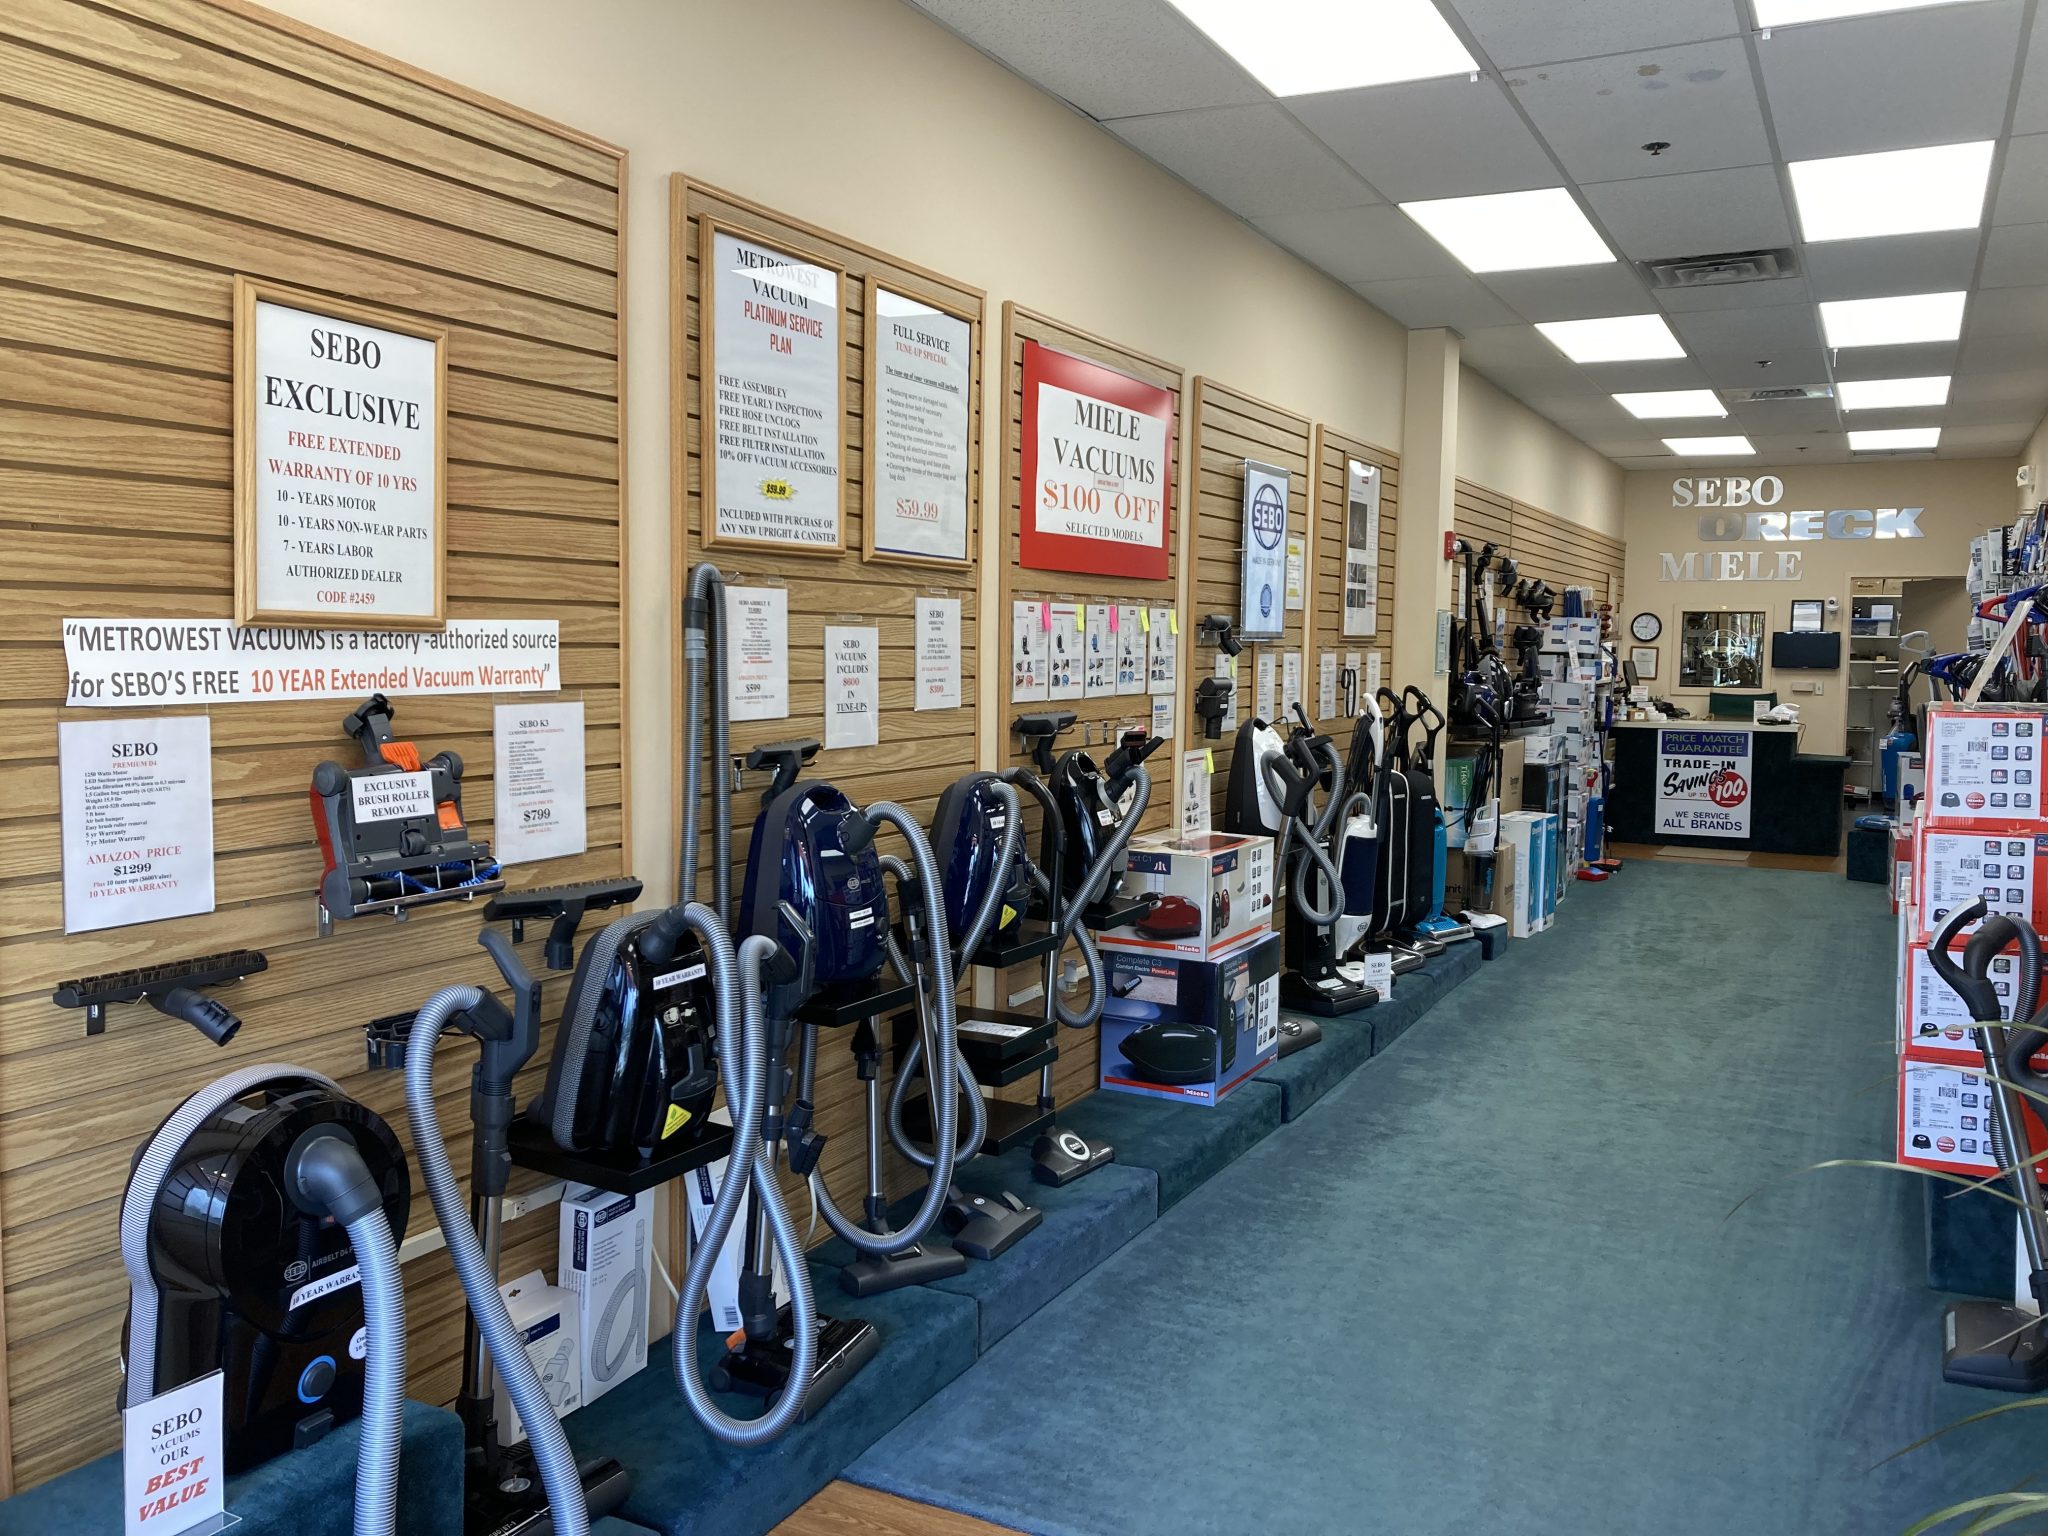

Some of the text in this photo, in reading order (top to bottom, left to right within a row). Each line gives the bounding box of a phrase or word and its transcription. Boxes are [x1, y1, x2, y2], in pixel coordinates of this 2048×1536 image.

[736, 247, 819, 289] METROWEST
[752, 279, 808, 309] VACUUM
[744, 300, 822, 338] PLATINUM SERVICE
[770, 334, 792, 355] PLAN
[893, 324, 950, 352] FULL SERVICE
[310, 329, 380, 369] SEBO
[923, 351, 947, 366] SPECIAL
[719, 375, 787, 398] FREE ASSEMBLEY
[265, 376, 419, 430] EXCLUSIVE
[719, 390, 822, 419] FREE YEARLY INSPECTIONS
[719, 405, 800, 429] FREE HOSE UNCLOGS
[1075, 399, 1140, 441] MIELE
[719, 419, 818, 445] FREE BELT INSTALLATION
[288, 431, 401, 461] FREE EXTENDED
[719, 434, 825, 461] FREE FILTER INSTALLATION
[719, 449, 837, 476] 10% OFF VACUUM ACCESSORIES
[1053, 437, 1155, 485] VACUUMS
[269, 459, 417, 492] WARRANTY OF 10 YRS
[277, 490, 376, 511] 10 YEARS MOTOR
[1043, 479, 1160, 524] $100 OFF
[1672, 475, 1784, 507] SEBO
[720, 508, 834, 529] INCLUDED WITH PURCHASE OF
[896, 497, 938, 519] $59.99
[1254, 503, 1282, 530] SEBO
[278, 515, 428, 539] 10 YEARS NON-WEAR PARTS
[720, 523, 836, 543] ANY NEW UPRIGHT & CANISTER
[1065, 522, 1143, 542] SELECTED MODELS
[1697, 507, 1925, 542] ORECK
[283, 540, 373, 558] 7 YEARS LABOR
[286, 565, 402, 583] AUTHORIZED DEALER
[1658, 551, 1803, 582] MIELE
[317, 590, 375, 605] CODE #2459
[228, 628, 325, 651] VACUUMS
[331, 631, 346, 649] is
[349, 634, 358, 649] a
[363, 631, 419, 652] factory
[512, 634, 557, 649] source
[843, 640, 860, 649] SEBO
[835, 652, 867, 661] VACUUMS
[837, 665, 868, 674] INCLUDES
[71, 673, 105, 699] for
[193, 670, 239, 693] FREE
[251, 670, 273, 692] 10
[279, 670, 324, 692] YEAR
[331, 667, 407, 690] Extended
[413, 667, 474, 689] Vacuum
[746, 684, 761, 693] $599
[843, 677, 860, 687] $600
[848, 690, 855, 699] IN
[837, 703, 868, 712] TUNE-UPS
[519, 720, 538, 728] SEBO
[1666, 733, 1744, 744] PRICE MATCH
[1667, 744, 1743, 754] GUARANTEE
[112, 742, 158, 758] SEBO
[113, 761, 148, 769] PREMIUM
[1664, 759, 1736, 770] TRADE-IN
[364, 779, 416, 792] EXCLUSIVE
[1664, 768, 1726, 796] SAVINGS
[358, 790, 429, 806] BRUSH ROLLER
[371, 804, 418, 817] REMOVAL
[523, 808, 550, 822] $799
[1693, 812, 1730, 820] SERVICE
[99, 829, 126, 837] Warranty
[1663, 819, 1742, 831] ALL BRANDS
[86, 846, 182, 865] AMAZON PRICE
[114, 863, 151, 876] $1299
[89, 880, 179, 898] 10 YEAR WARRANTY
[1116, 955, 1150, 965] Complete
[661, 968, 703, 984] YEAR WARRANTY
[1152, 968, 1176, 976] PowerLine
[285, 1249, 349, 1278] SEBO AIRBELT D4
[292, 1285, 324, 1306] 10 YEAR
[151, 1407, 203, 1441] SEBO
[151, 1427, 201, 1454] VACUUMS
[160, 1445, 189, 1466] OUR
[144, 1456, 204, 1496] BEST
[138, 1477, 210, 1522] VALUE
